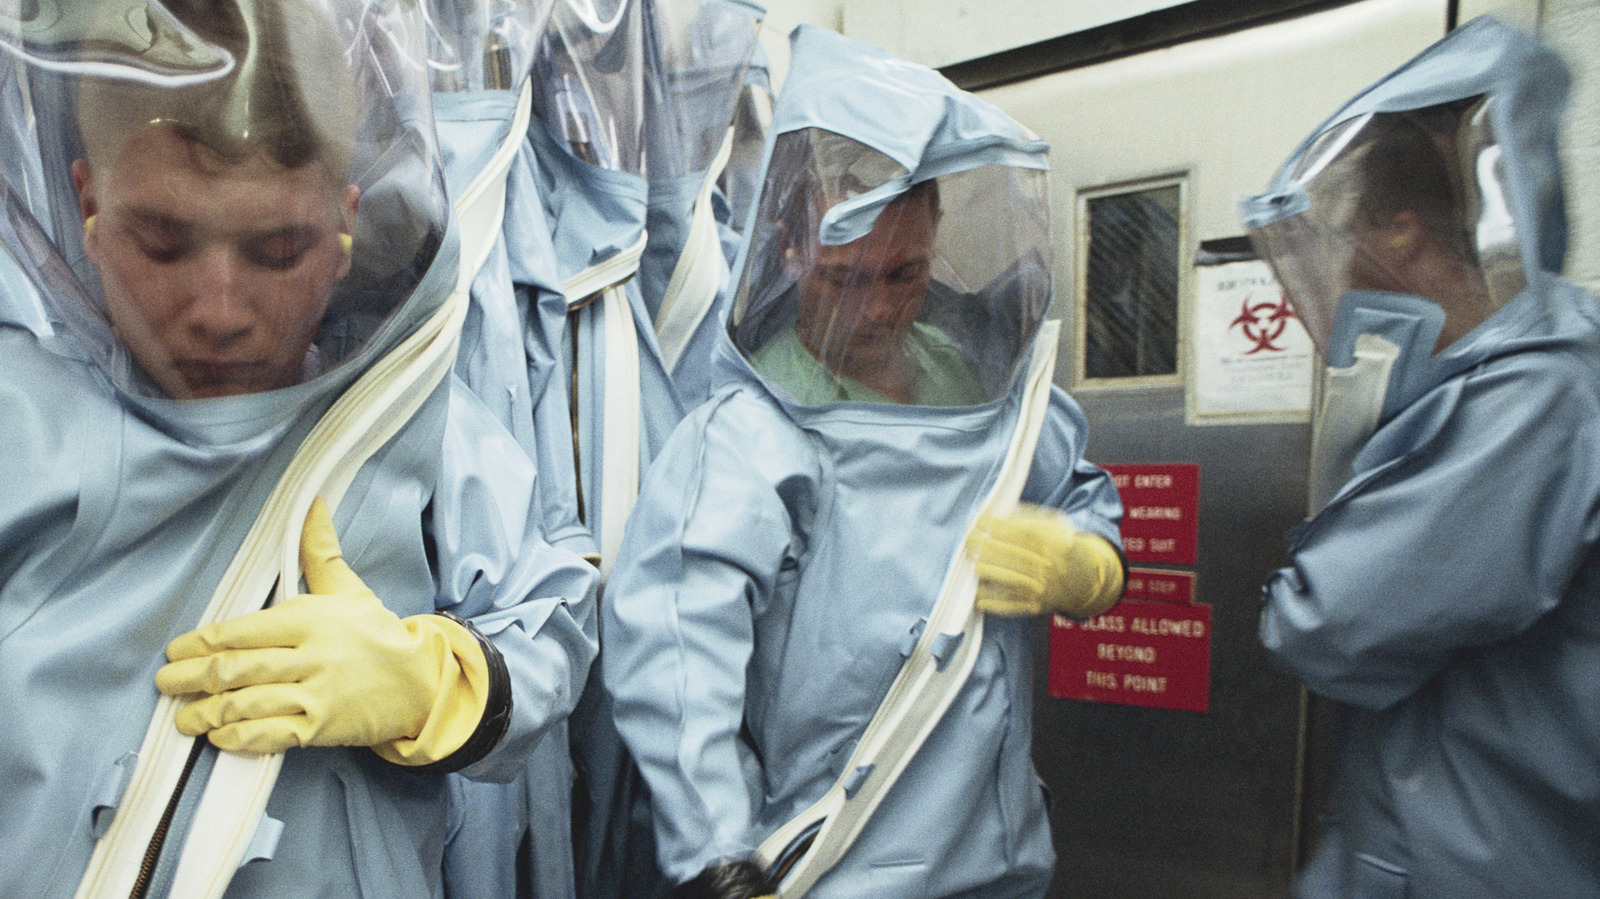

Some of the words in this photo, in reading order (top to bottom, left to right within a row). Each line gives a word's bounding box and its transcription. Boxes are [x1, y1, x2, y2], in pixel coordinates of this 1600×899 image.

[1134, 474, 1172, 489] ENTER
[1129, 506, 1181, 521] WEARING
[1149, 538, 1175, 552] SUIT
[1131, 617, 1205, 638] ALLOWED
[1097, 643, 1156, 664] BEYOND
[1086, 670, 1118, 690] THIS
[1123, 674, 1168, 693] POINT
